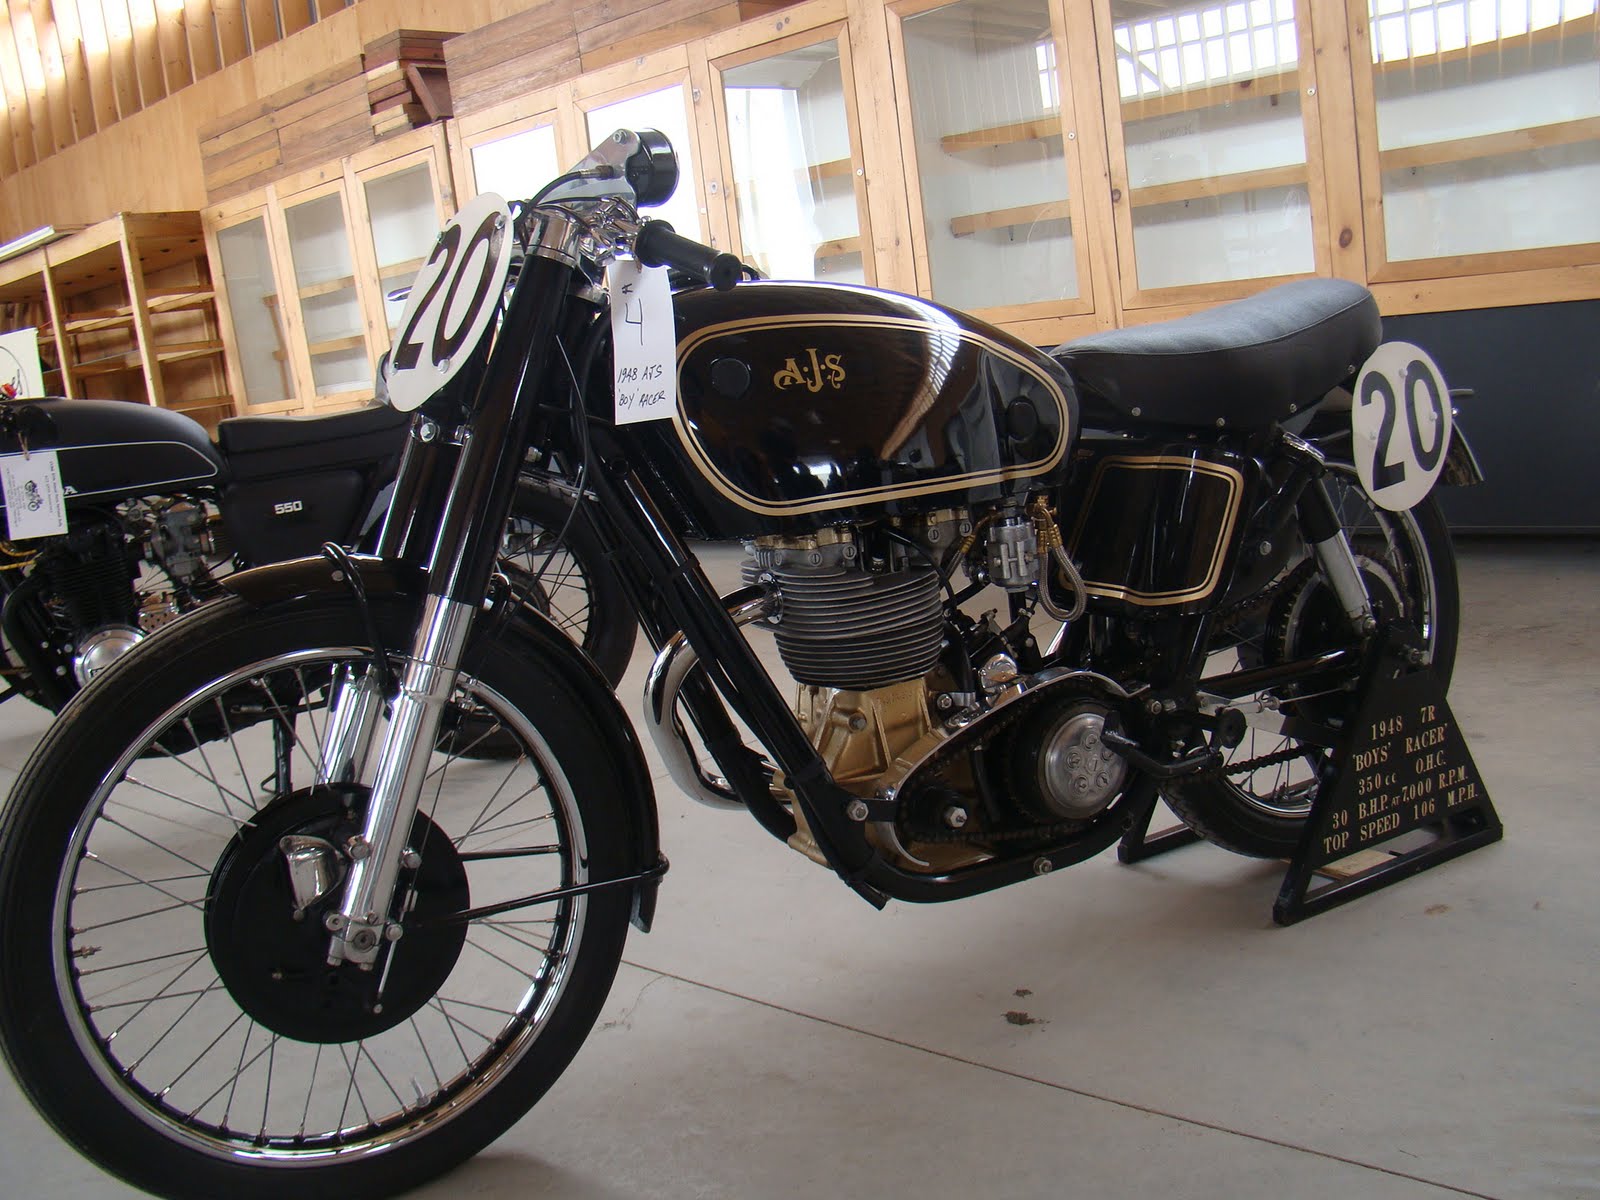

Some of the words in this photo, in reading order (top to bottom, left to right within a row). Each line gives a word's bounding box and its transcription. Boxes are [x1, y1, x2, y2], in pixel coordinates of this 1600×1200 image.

[394, 211, 506, 370] 20
[624, 298, 644, 346] 4
[617, 367, 639, 384] 1948
[641, 364, 663, 381] AJS
[639, 390, 666, 407] RACER
[1361, 360, 1444, 492] 20
[274, 500, 303, 515] 550
[1371, 715, 1403, 741] 1948
[1420, 704, 1436, 724] 7R
[1358, 773, 1381, 796] 350
[1415, 750, 1446, 774] O.H.C.
[1323, 831, 1350, 854] TOP
[1359, 812, 1400, 842] SPEED
[1413, 798, 1435, 820] 106
[1447, 783, 1479, 808] M.P.H.
[1332, 809, 1348, 830] 30
[1438, 765, 1468, 790] R.P.M.
